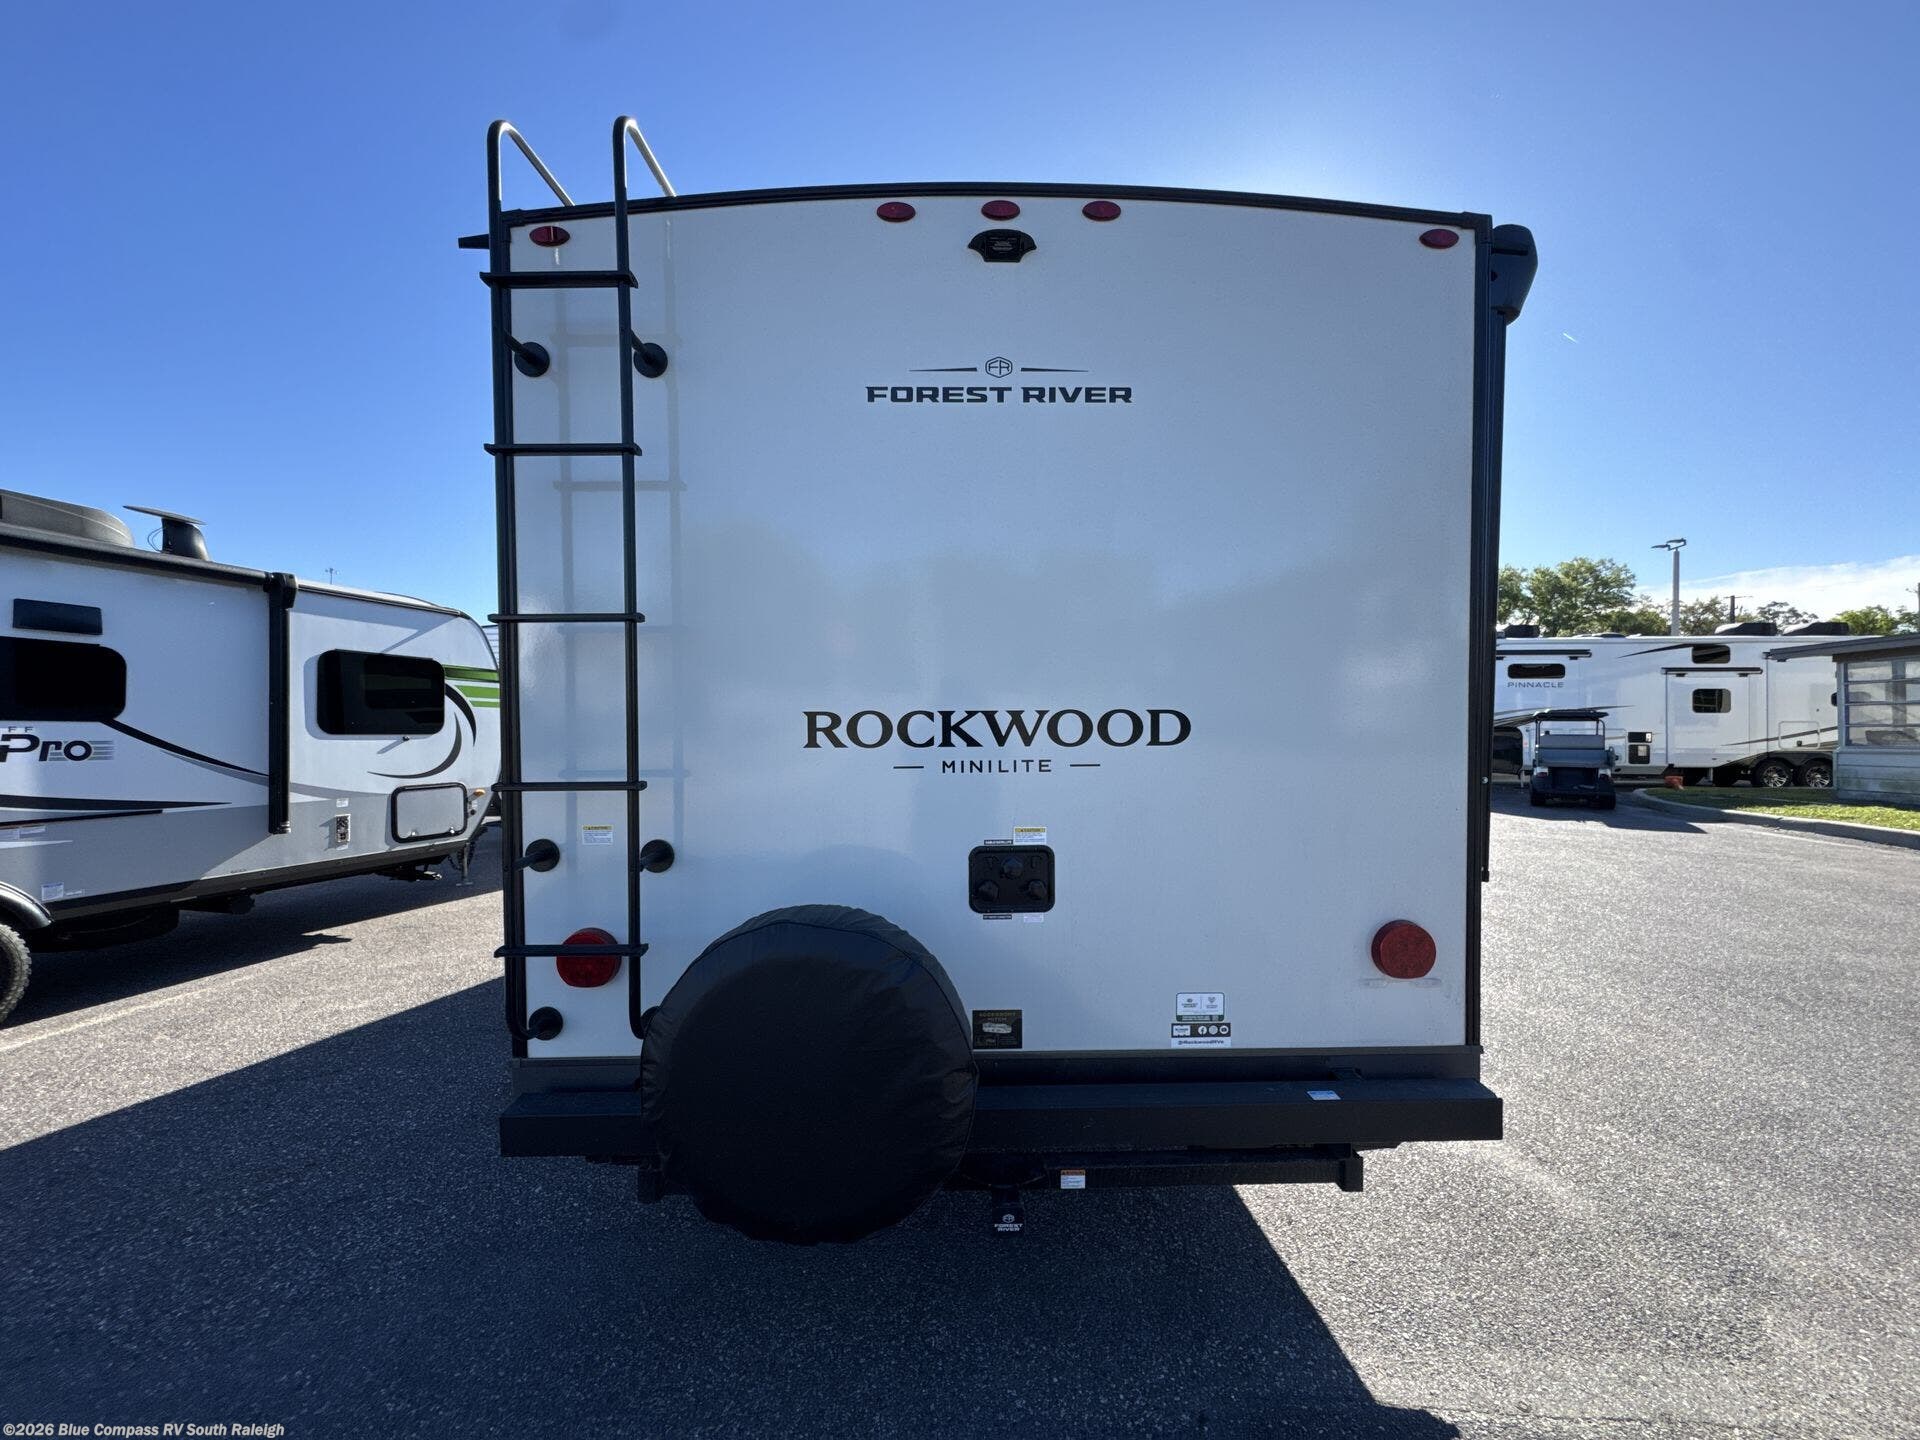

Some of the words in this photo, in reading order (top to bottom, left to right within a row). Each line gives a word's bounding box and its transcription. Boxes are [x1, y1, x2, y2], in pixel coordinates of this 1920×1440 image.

[865, 386, 1012, 403] FOREST
[1021, 386, 1133, 403] RIVER
[1507, 681, 1565, 689] PINNACLE
[802, 709, 1192, 749] ROCKWOOD
[942, 759, 1052, 774] MINILITE
